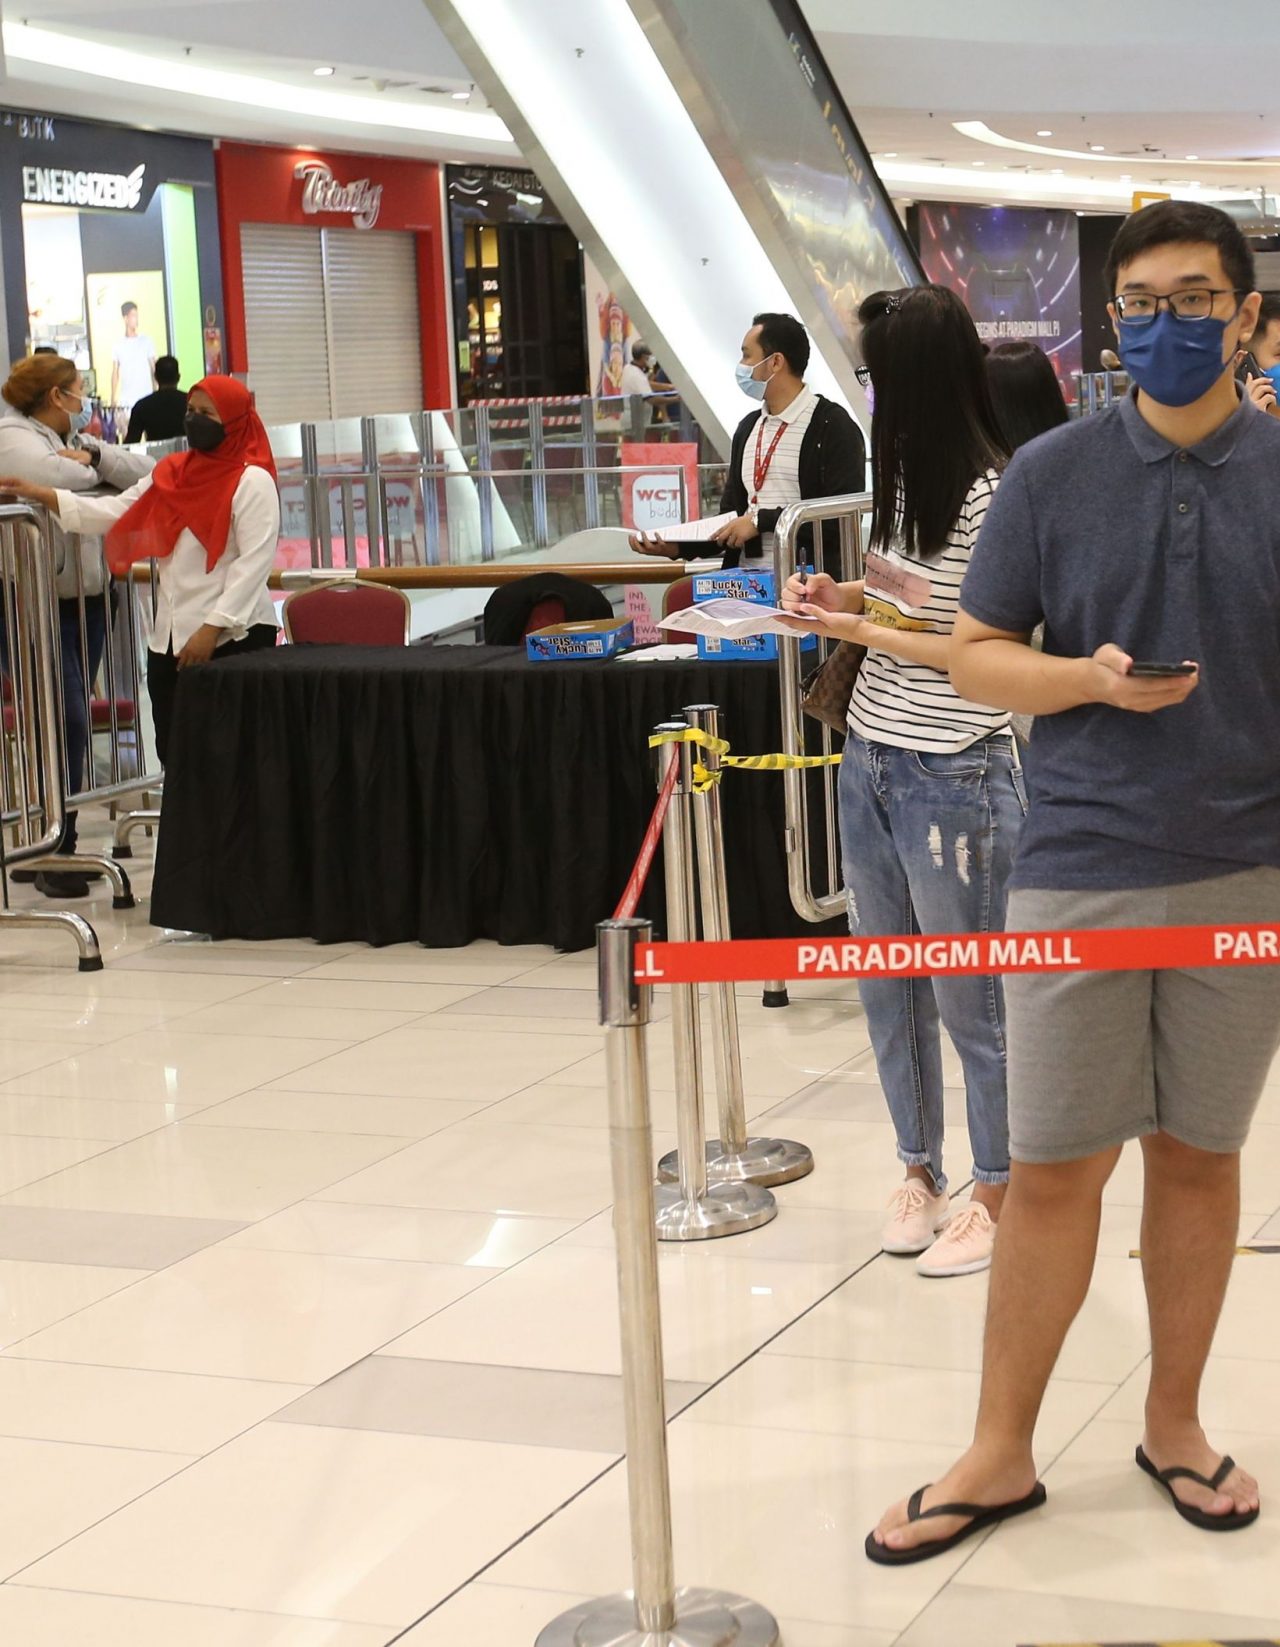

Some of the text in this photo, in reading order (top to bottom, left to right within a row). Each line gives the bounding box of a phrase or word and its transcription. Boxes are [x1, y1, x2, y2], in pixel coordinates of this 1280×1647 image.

[636, 489, 681, 501] WCT
[711, 579, 743, 590] Lucky
[727, 588, 750, 599] Star
[548, 636, 570, 646] Star
[555, 644, 587, 655] Lucky
[797, 936, 1081, 973] PARADIGM MALL
[634, 949, 664, 977] L
